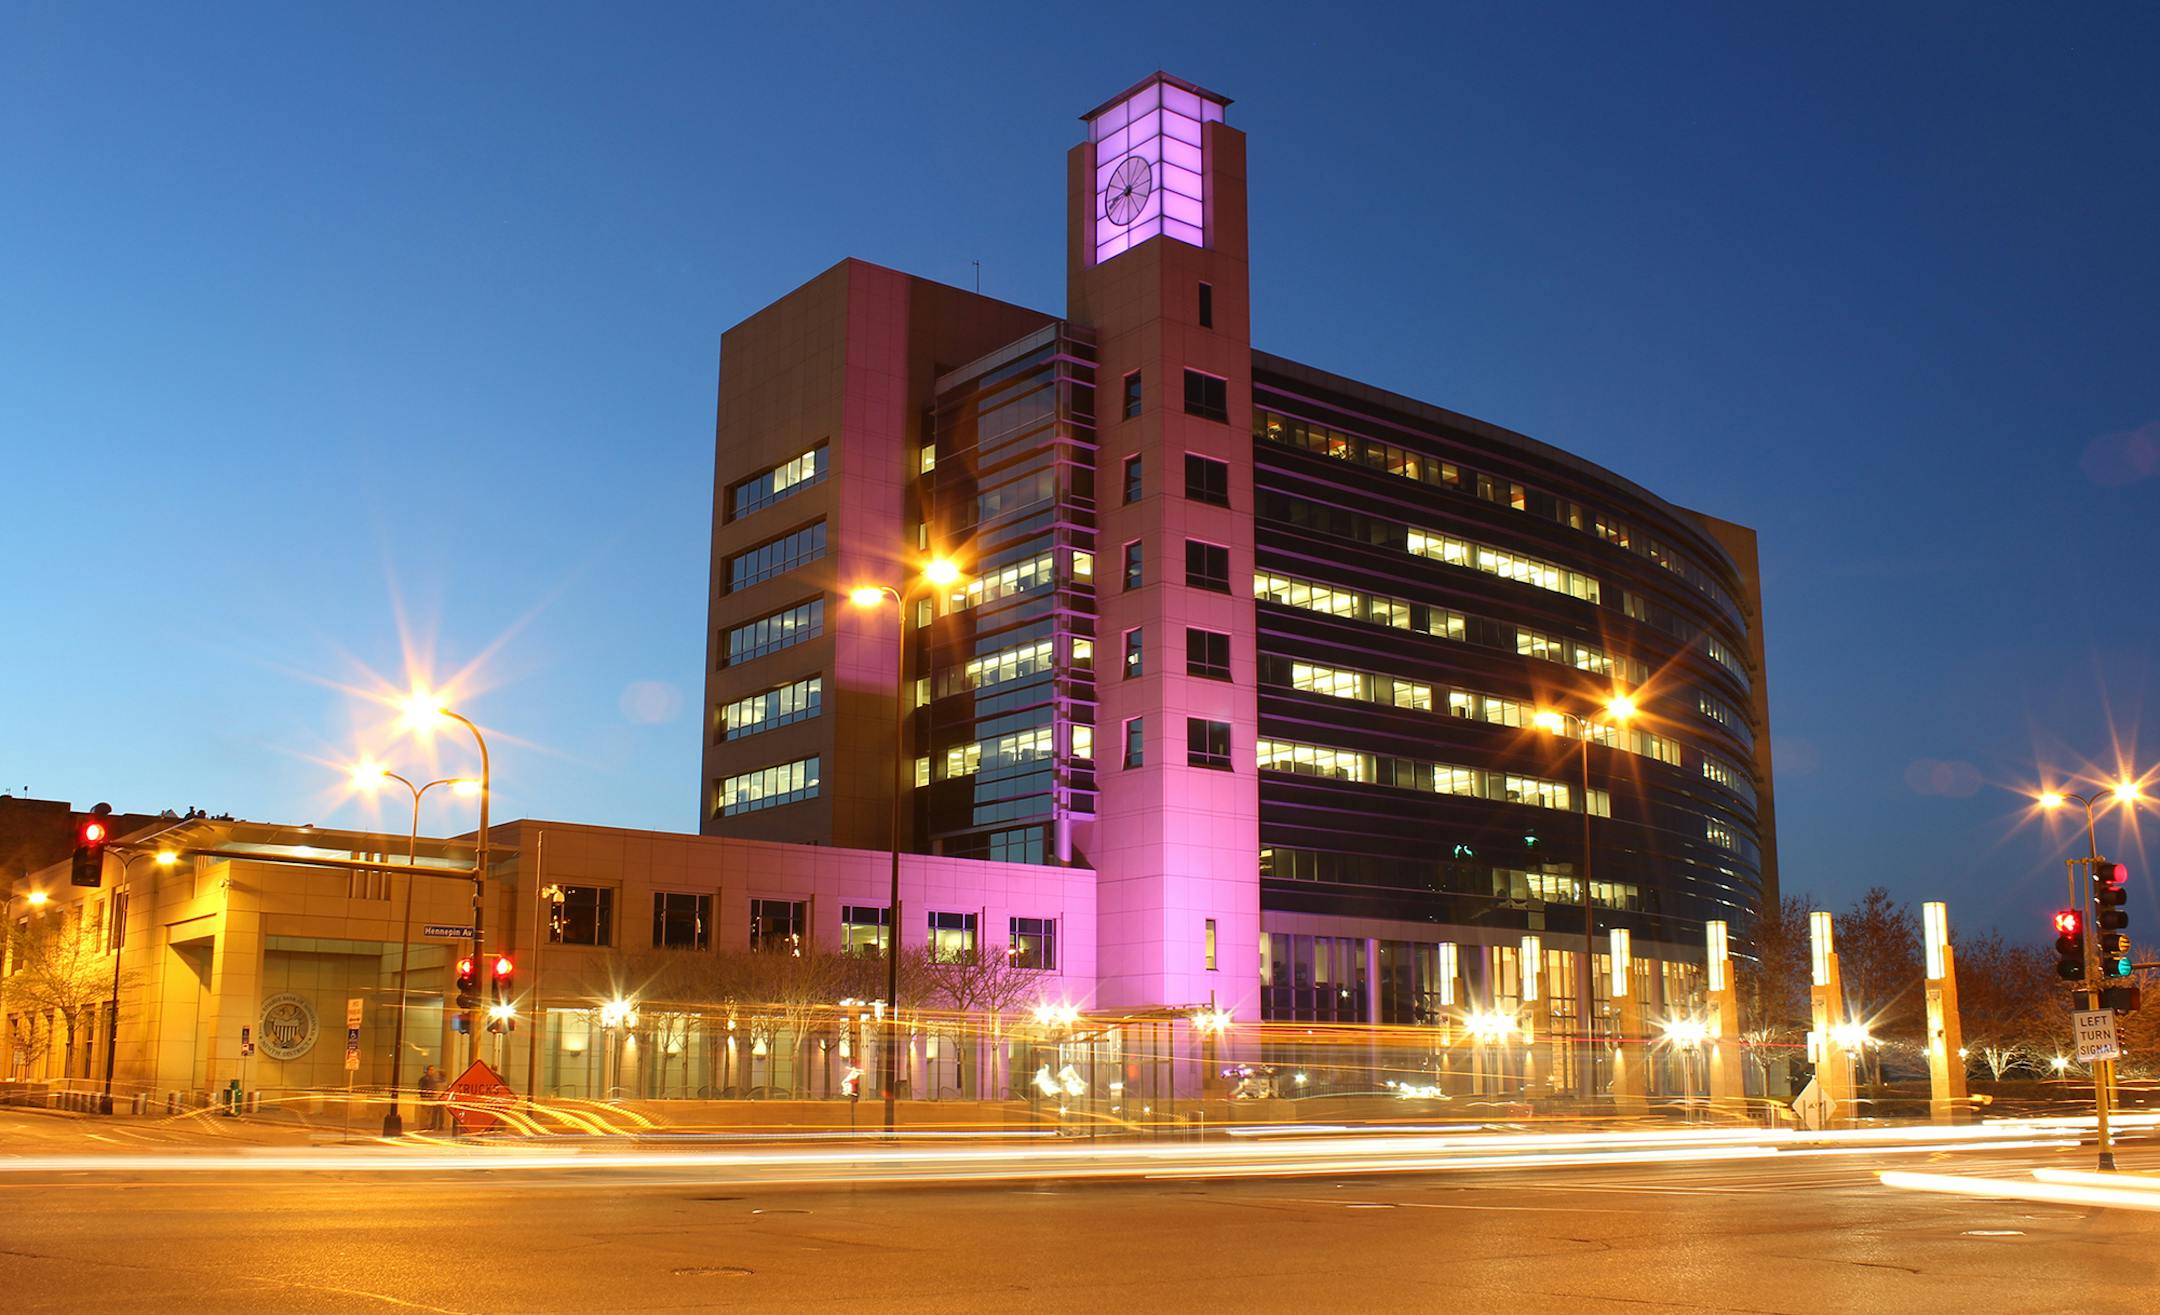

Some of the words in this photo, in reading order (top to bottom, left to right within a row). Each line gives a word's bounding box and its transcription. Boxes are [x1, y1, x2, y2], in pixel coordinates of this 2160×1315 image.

[424, 927, 461, 937] Hennepin
[2080, 1015, 2107, 1027] LEFT
[2080, 1030, 2111, 1041] TURN
[2080, 1043, 2116, 1055] SIGNAL
[458, 1083, 500, 1095] TRUCKS
